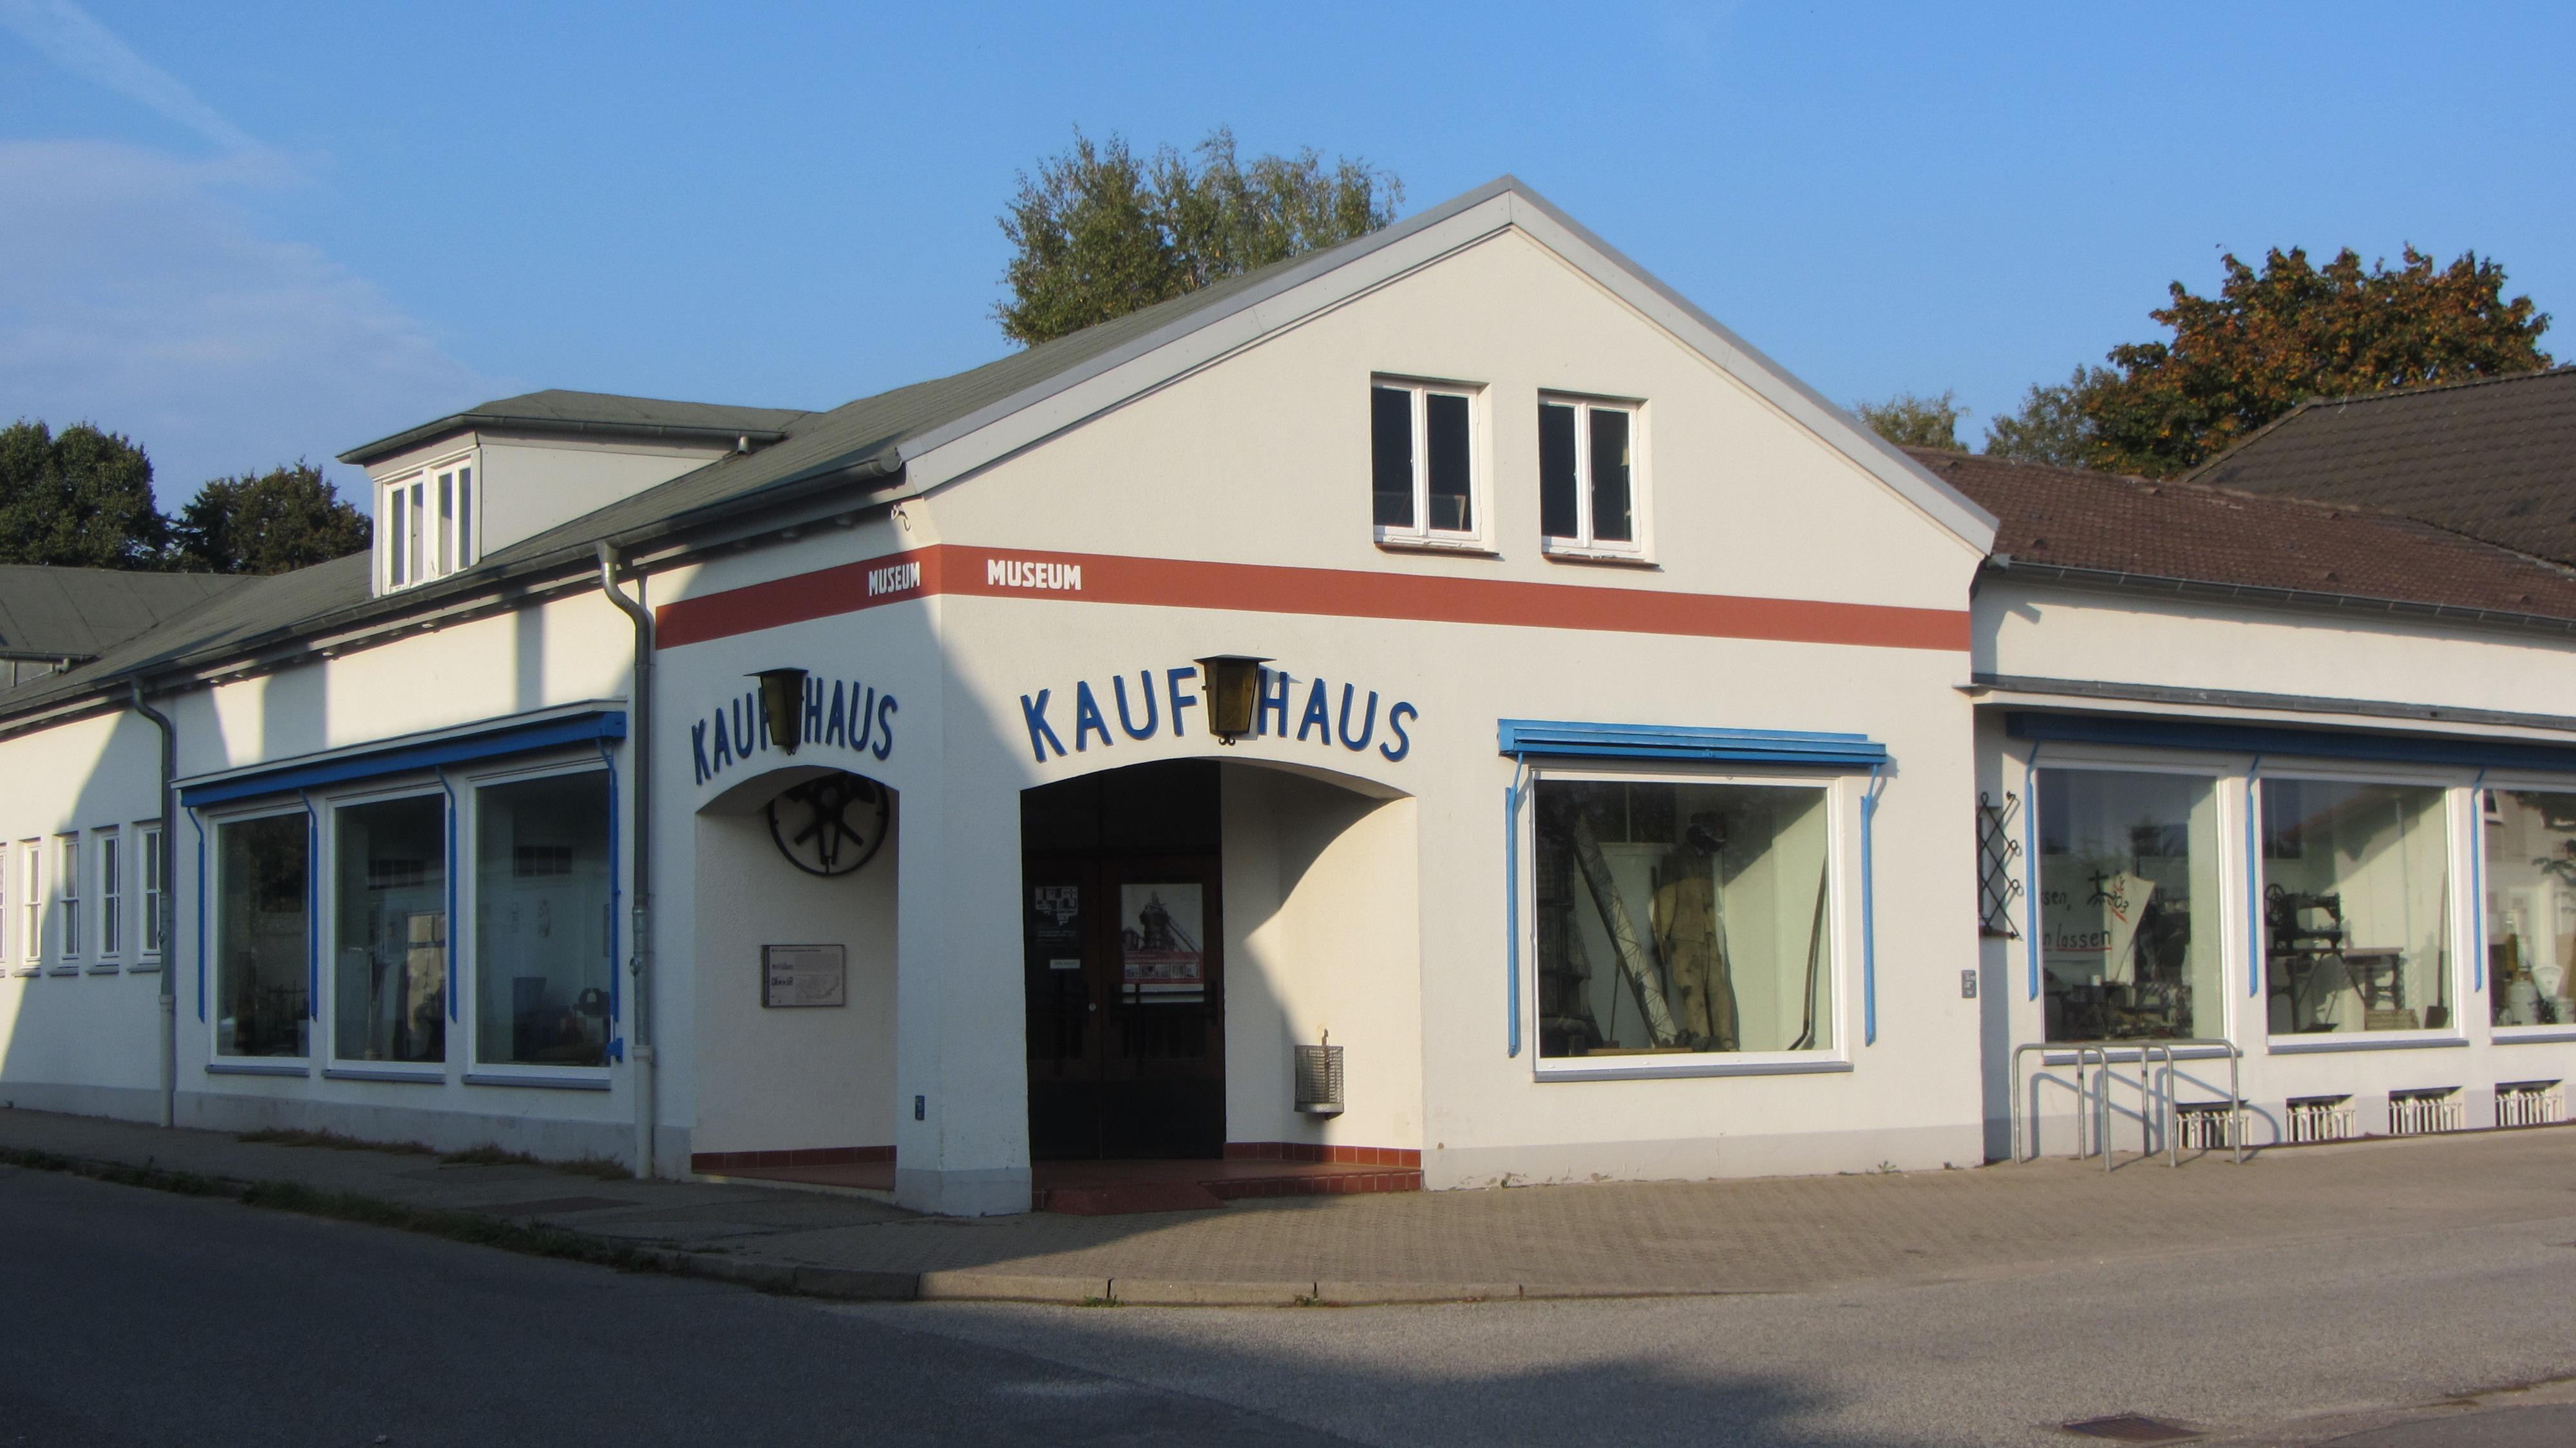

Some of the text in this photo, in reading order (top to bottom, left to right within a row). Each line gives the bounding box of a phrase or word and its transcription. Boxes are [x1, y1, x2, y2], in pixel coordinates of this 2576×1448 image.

[868, 561, 920, 596] MUSEUM
[987, 559, 1081, 591] MUSEUM
[2056, 923, 2111, 948] lassen
